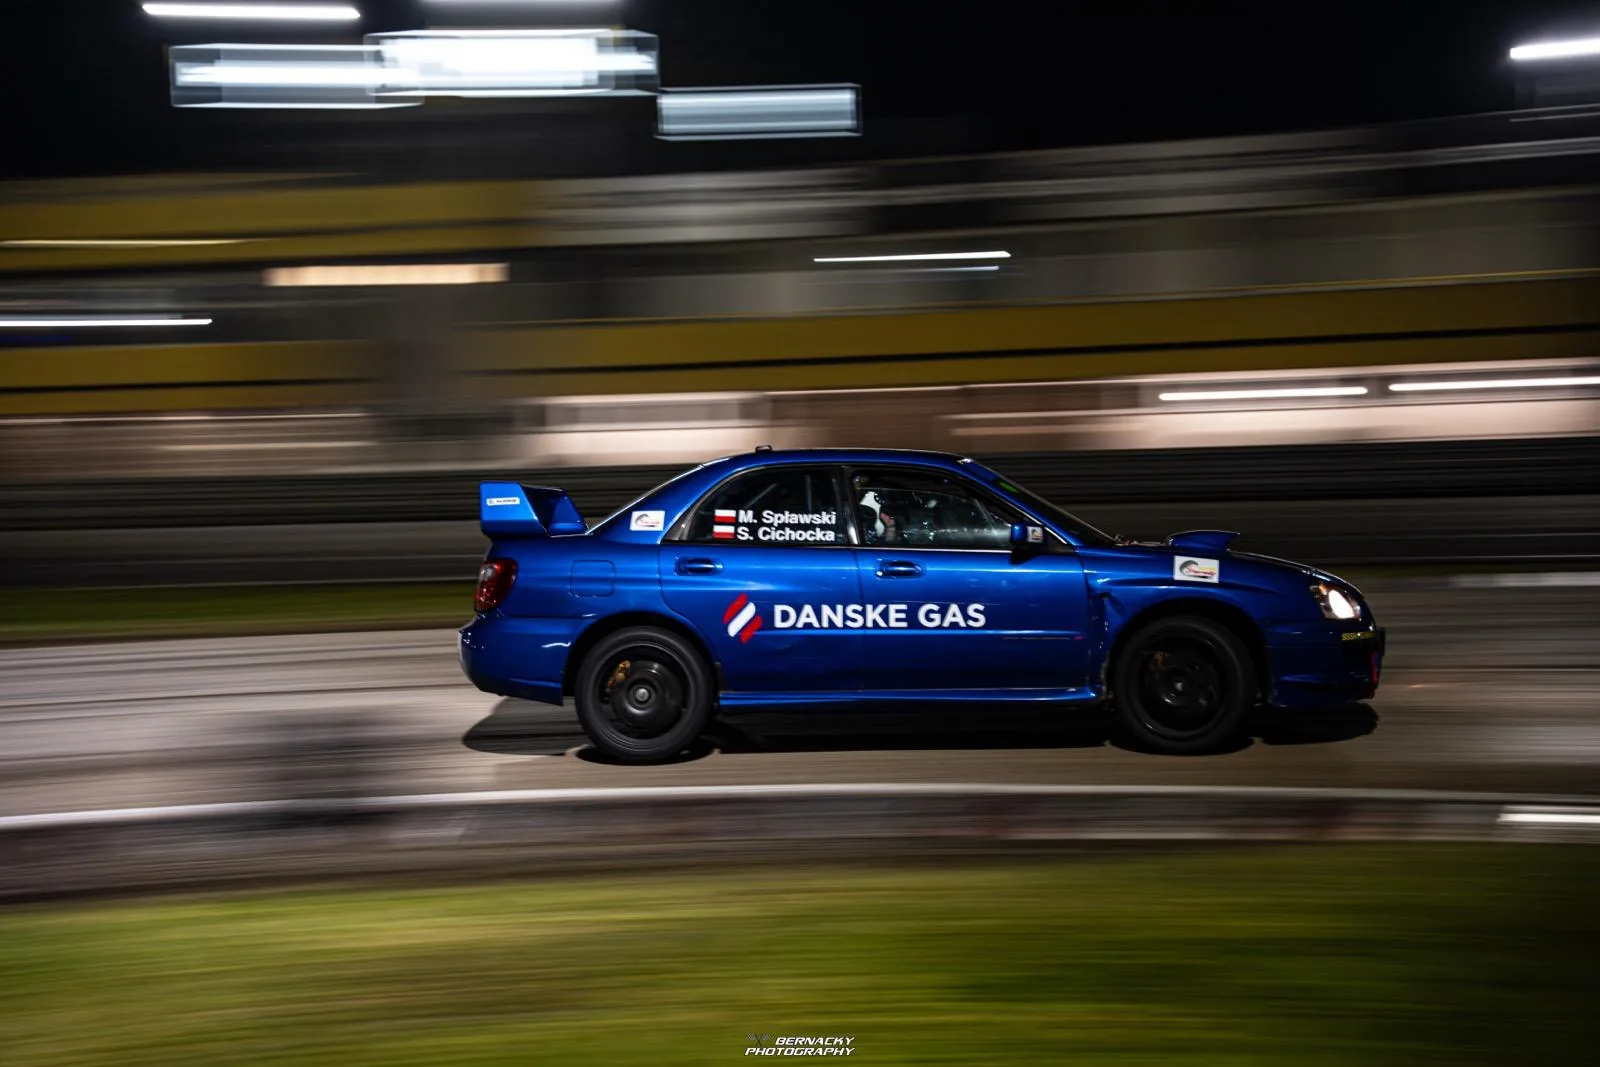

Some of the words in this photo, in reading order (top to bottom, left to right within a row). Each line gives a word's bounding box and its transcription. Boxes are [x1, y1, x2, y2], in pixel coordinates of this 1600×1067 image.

[738, 509, 758, 524] M.
[761, 509, 837, 527] Spławski
[736, 526, 754, 541] S.
[757, 526, 835, 542] Cichocka
[773, 604, 908, 628] DANSKE
[917, 603, 987, 628] GAS
